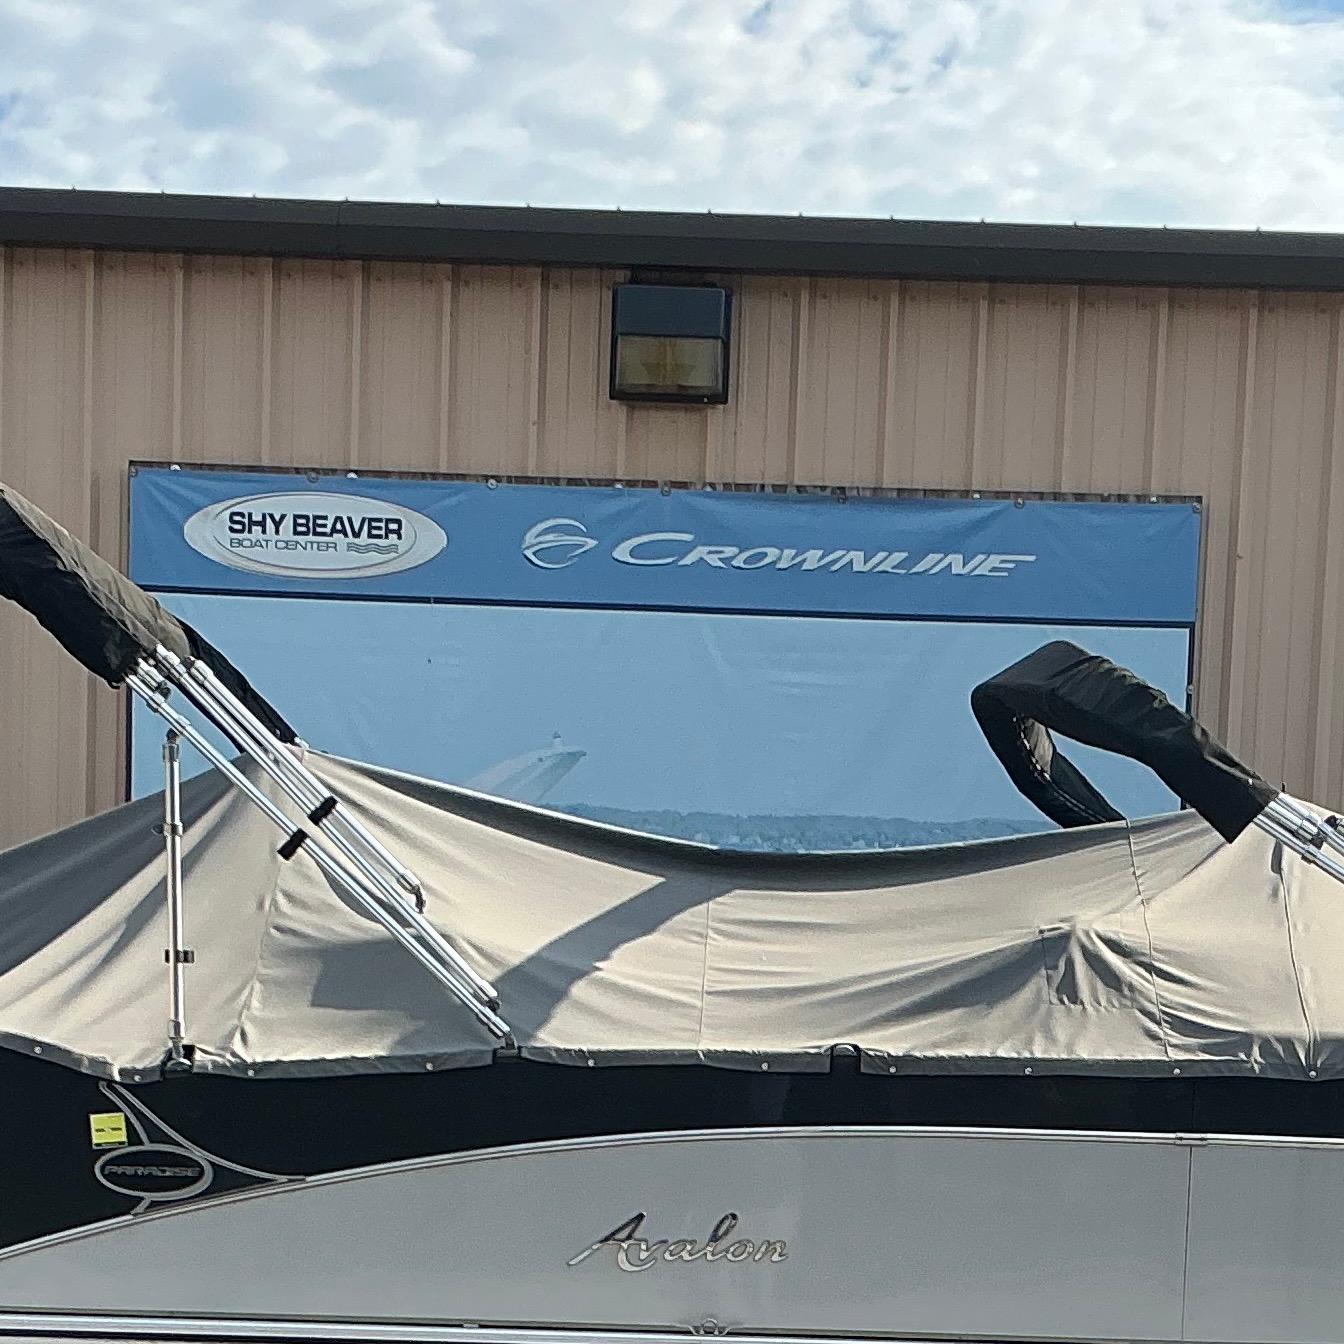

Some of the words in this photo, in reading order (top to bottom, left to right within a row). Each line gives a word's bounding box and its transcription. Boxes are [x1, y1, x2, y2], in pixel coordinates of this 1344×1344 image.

[228, 511, 288, 536] SHY
[292, 514, 403, 541] BEAVER
[229, 537, 273, 551] BOAT
[274, 540, 339, 553] CENTER
[611, 531, 1038, 578] CROWNLINE
[567, 1211, 789, 1272] Avalon
